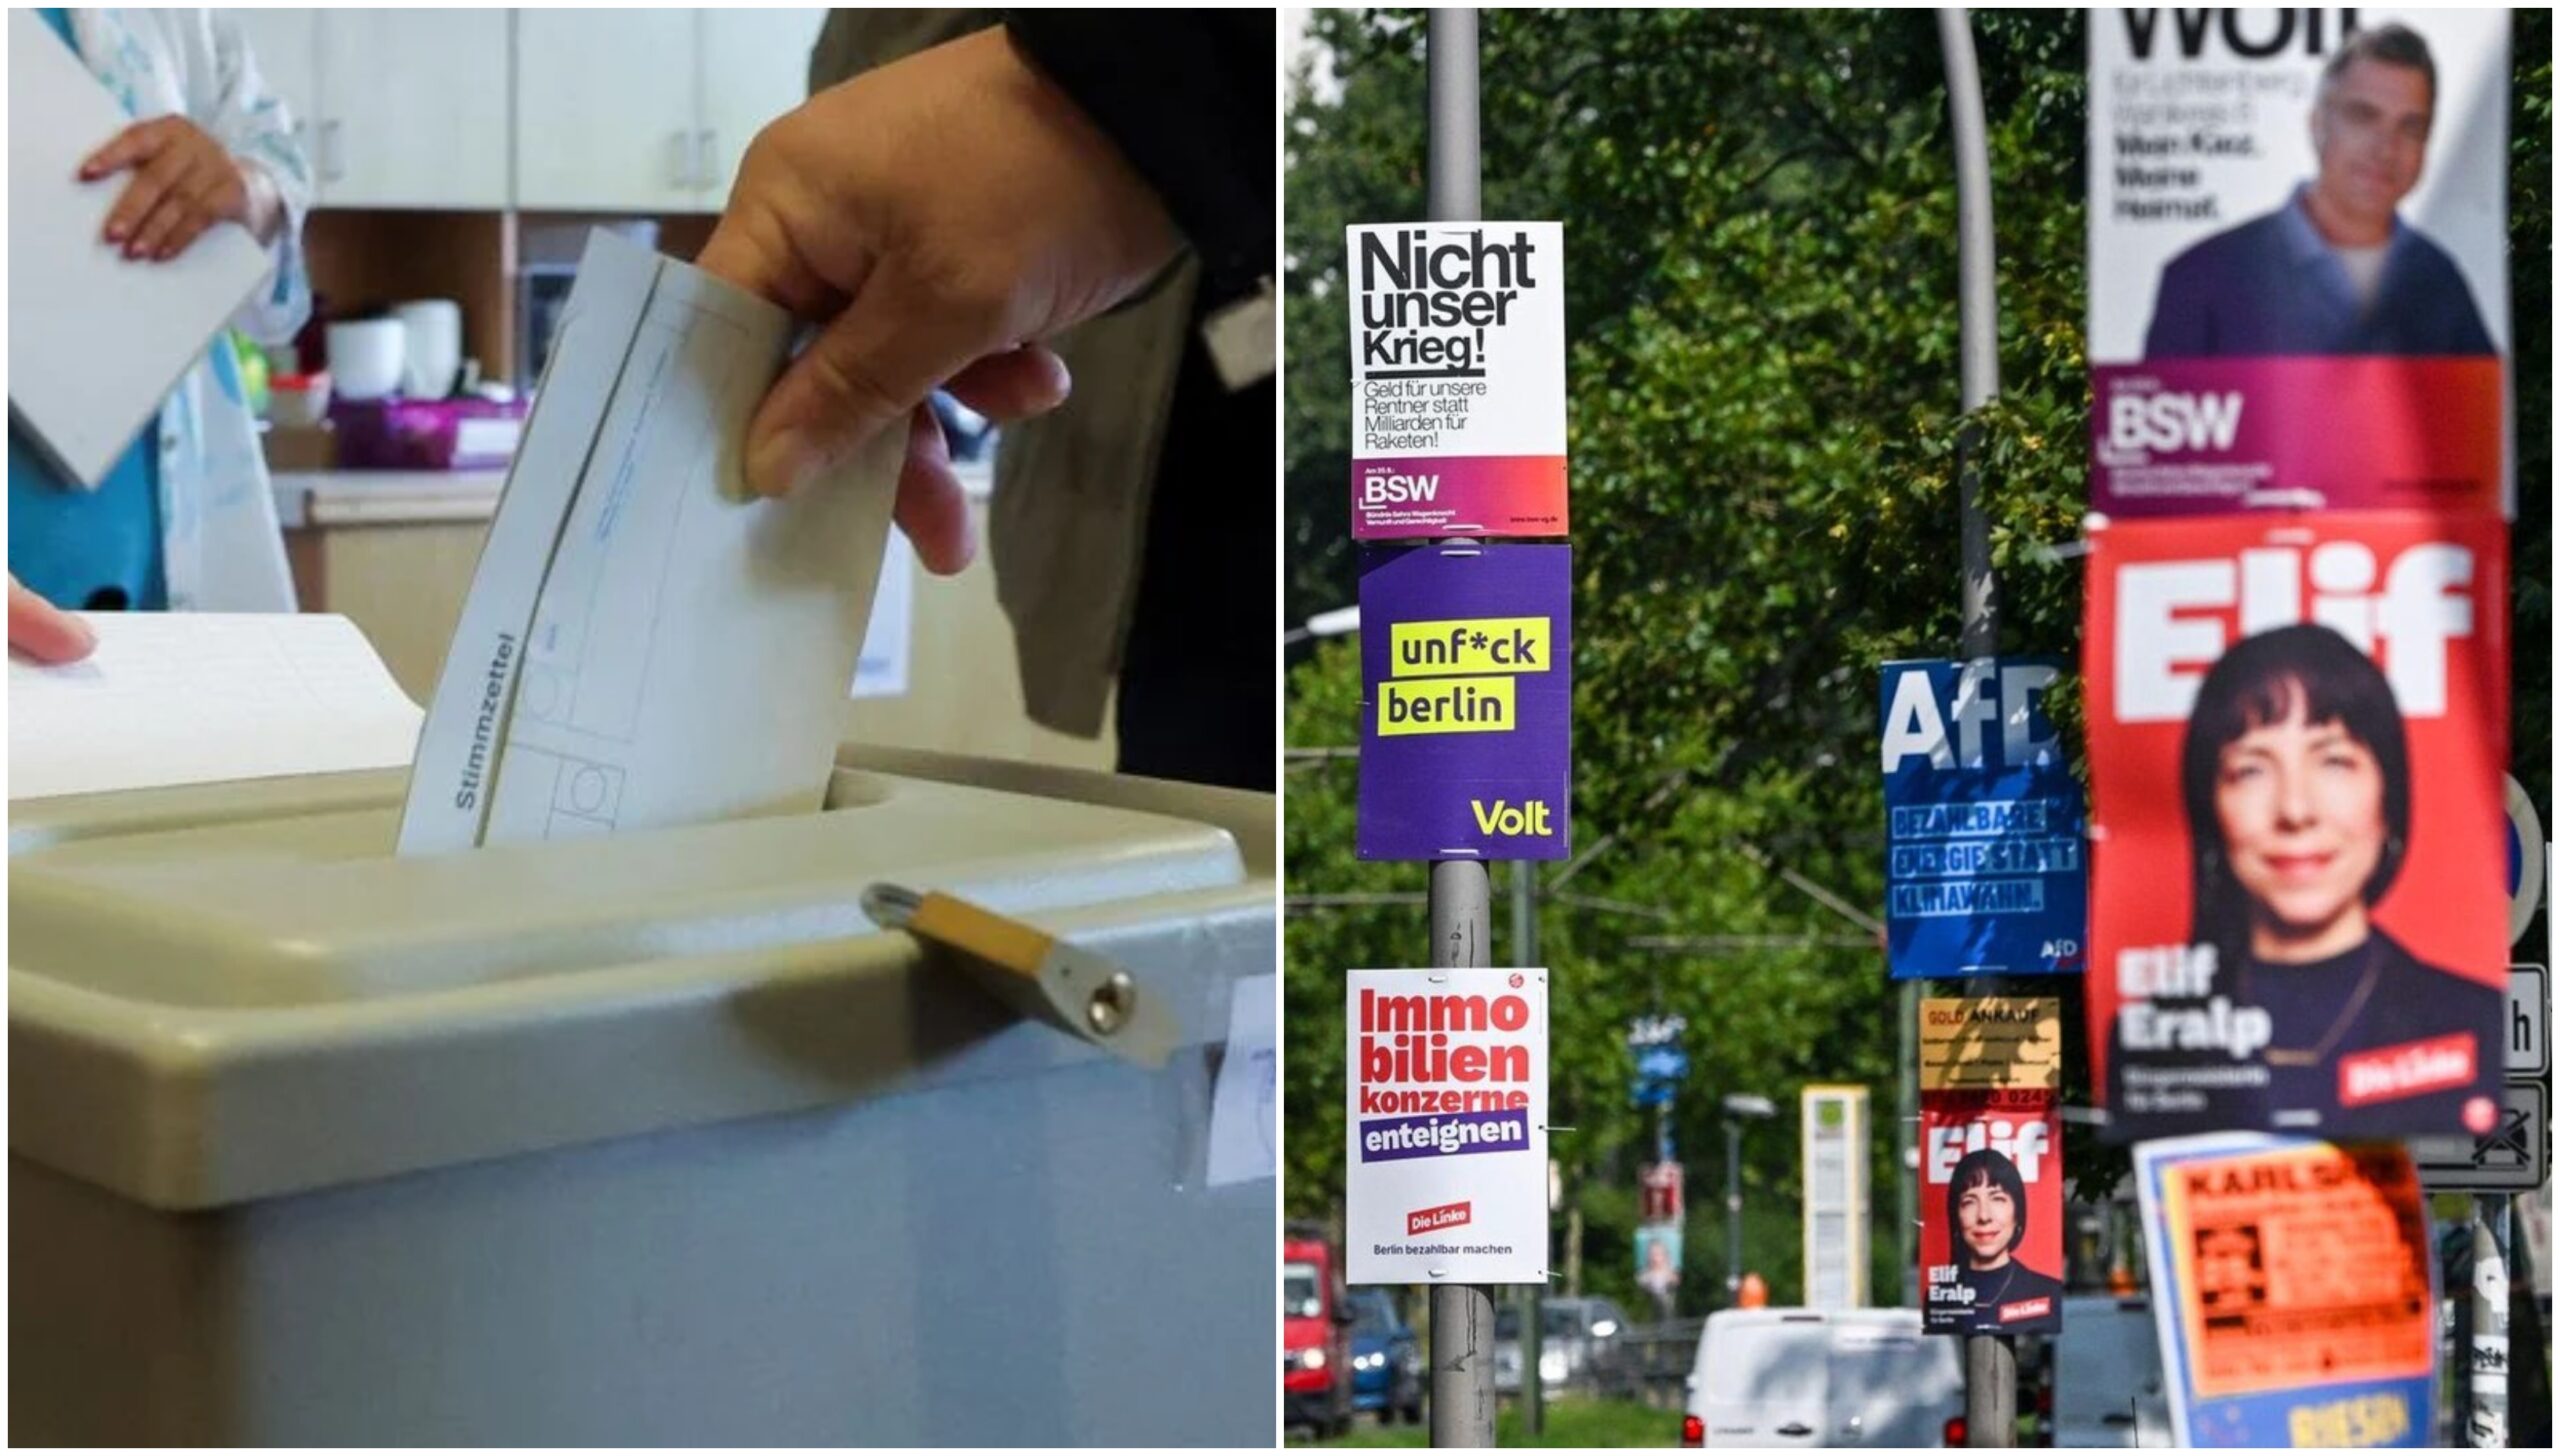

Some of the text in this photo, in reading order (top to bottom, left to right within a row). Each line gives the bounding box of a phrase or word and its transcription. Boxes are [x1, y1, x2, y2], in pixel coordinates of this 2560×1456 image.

[2121, 8, 2357, 59] Wol
[1361, 229, 1536, 291] Nicht
[1362, 290, 1518, 329] unser
[1363, 328, 1486, 372] Krieg!
[1364, 381, 1487, 398] Geld für unsere
[1364, 398, 1469, 415] Rentner statt
[1364, 414, 1468, 432] Milliarden für
[2109, 391, 2243, 452] BSW
[1364, 432, 1439, 449] Raketen!
[1365, 475, 1439, 503] BSW
[2114, 541, 2474, 723] Elif
[455, 632, 516, 812] Stimmzettel
[1388, 686, 1502, 723] berlin
[1881, 656, 2062, 773] AfD
[1470, 800, 1552, 835] Volt
[1895, 804, 2042, 836] BEZAHLBARE
[1895, 842, 2076, 876] ENERGIE STATT
[2041, 939, 2078, 958] AfD
[2117, 943, 2219, 997] Elif
[1360, 989, 1529, 1032] Immo
[1928, 1009, 2040, 1025] GOLD ANKAUF
[2118, 996, 2272, 1058] Eralp
[1360, 1033, 1529, 1083] bilien
[1360, 1085, 1529, 1114] konzerne
[1365, 1117, 1522, 1153] enteignen
[1411, 1209, 1467, 1230] Die Linke
[1373, 1244, 1513, 1256] Berlin bezahlbar machen
[1928, 1264, 1958, 1283] Elif
[1928, 1284, 1977, 1305] Eralp
